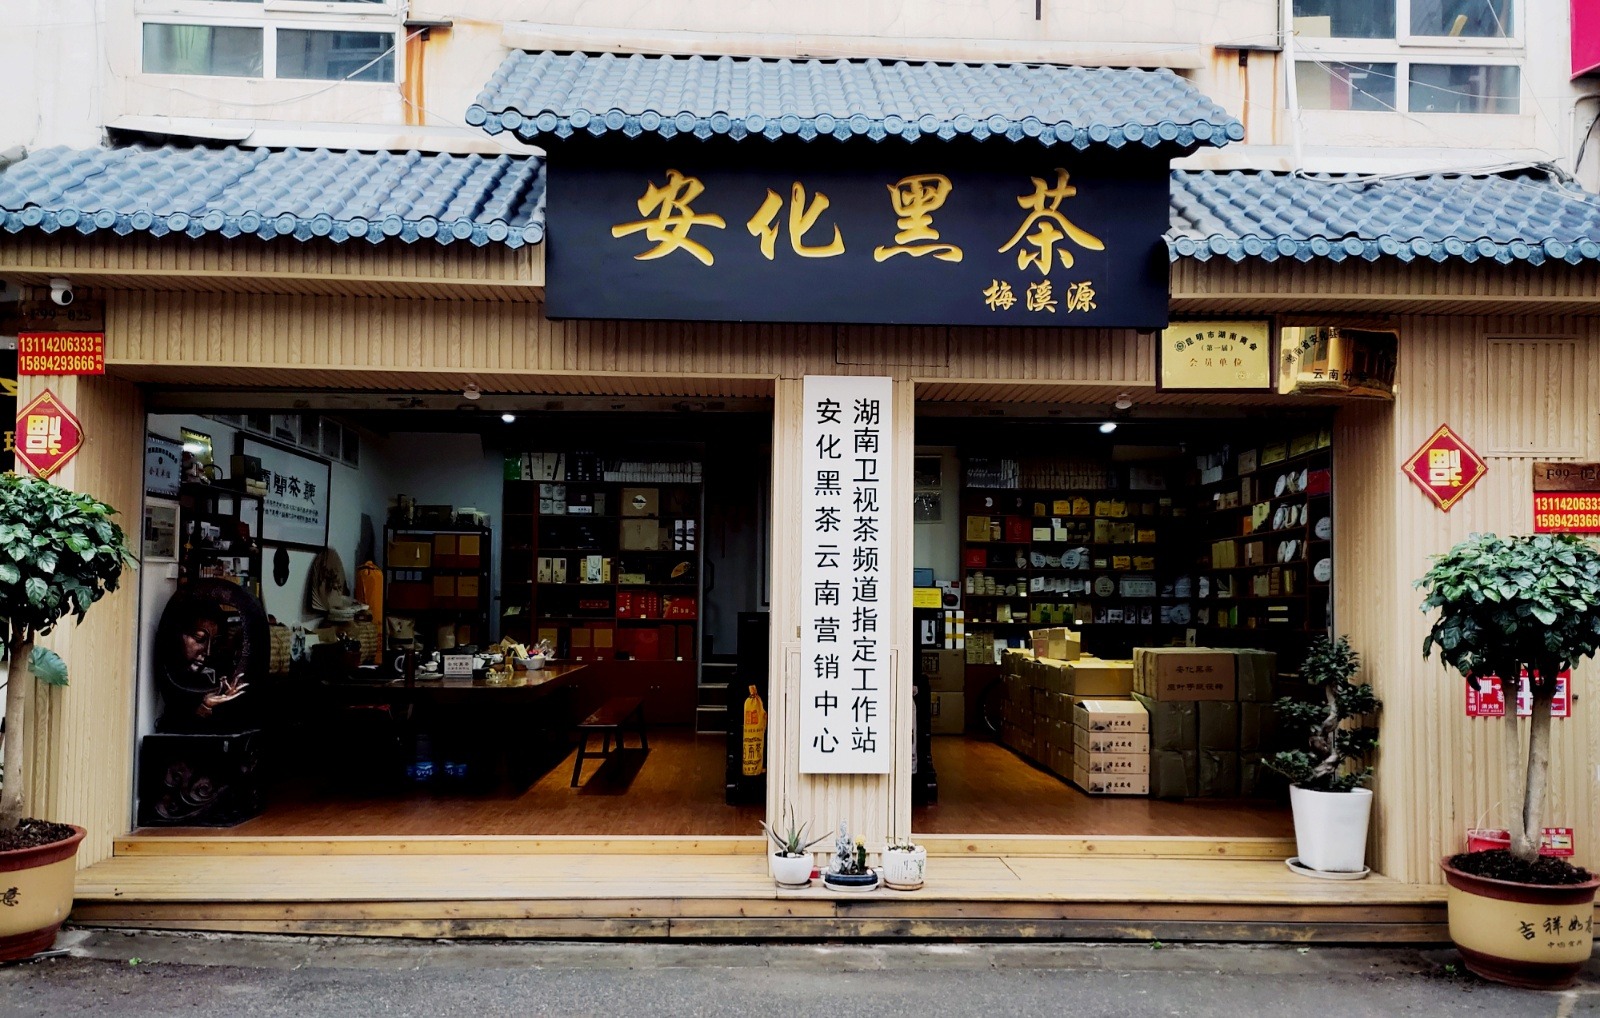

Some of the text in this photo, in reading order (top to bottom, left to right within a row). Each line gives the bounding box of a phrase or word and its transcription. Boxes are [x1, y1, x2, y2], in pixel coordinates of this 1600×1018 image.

[611, 167, 1106, 276] 安化黑茶
[983, 278, 1098, 314] 梅溪源
[20, 336, 94, 352] 13114206333
[20, 355, 95, 371] 15894293666
[1189, 357, 1243, 367] 会员单位
[1536, 513, 1600, 528] 1589429366
[813, 398, 842, 754] 安化黑茶云南营销中心
[851, 398, 880, 754] 湖南卫视茶频道指定工作站
